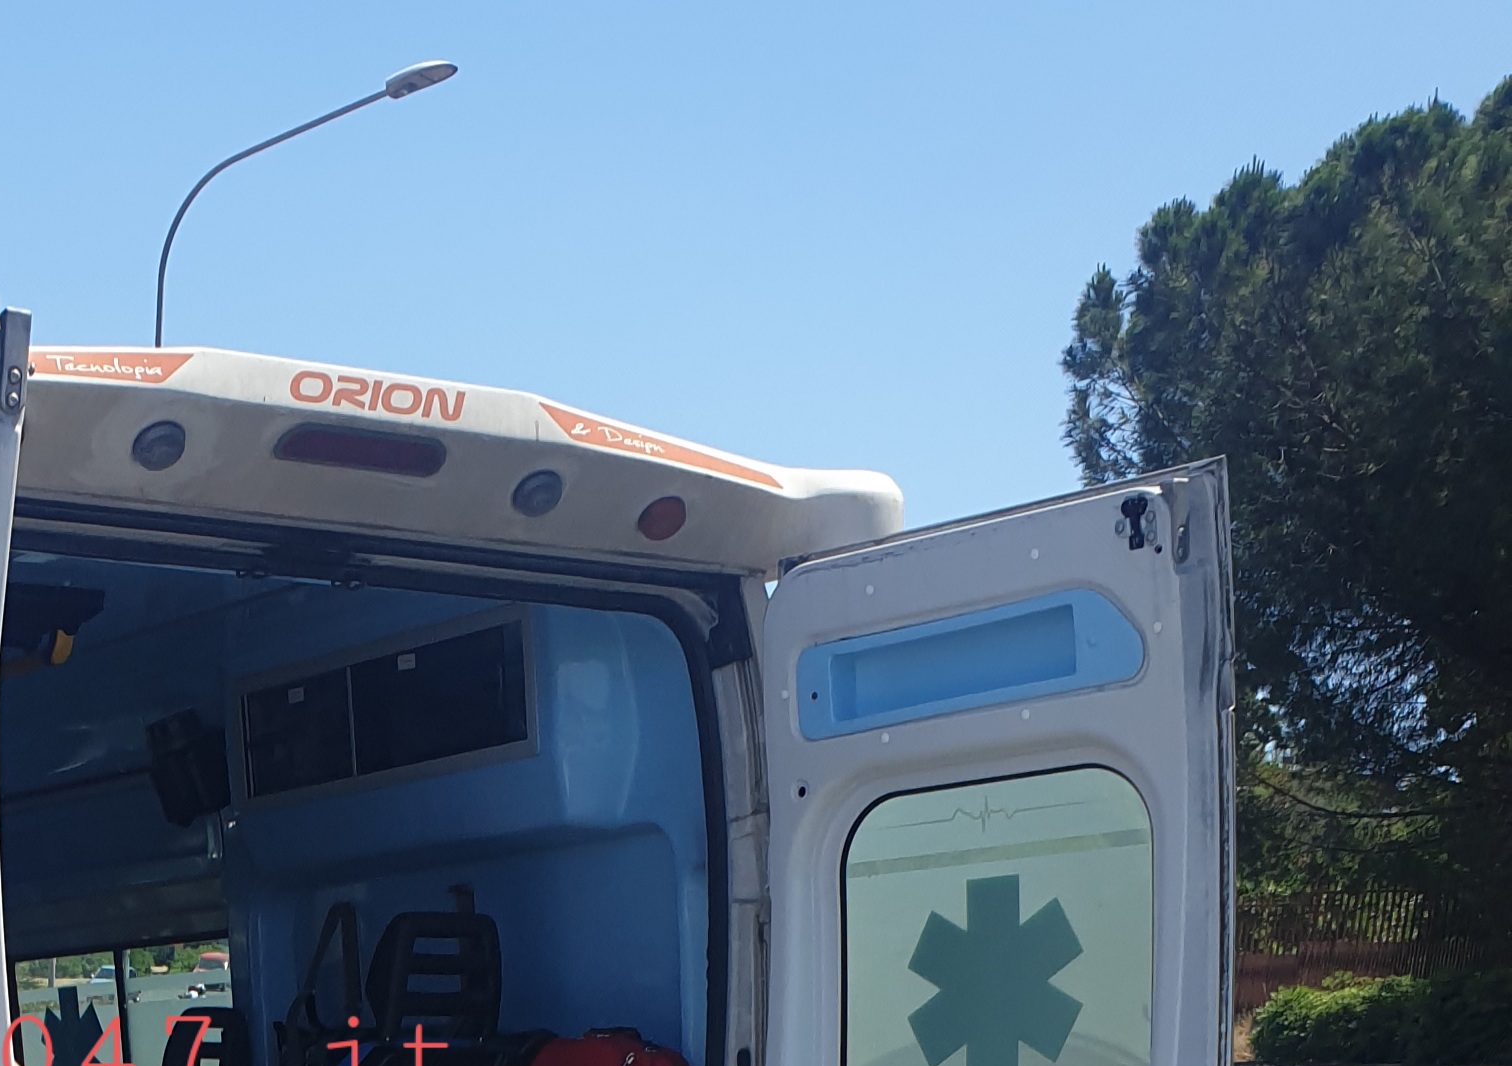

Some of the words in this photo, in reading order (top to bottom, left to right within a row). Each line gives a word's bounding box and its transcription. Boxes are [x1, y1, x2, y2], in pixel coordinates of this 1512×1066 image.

[46, 354, 163, 379] Tecnologia
[290, 370, 466, 421] ORION
[598, 427, 665, 454] Design
